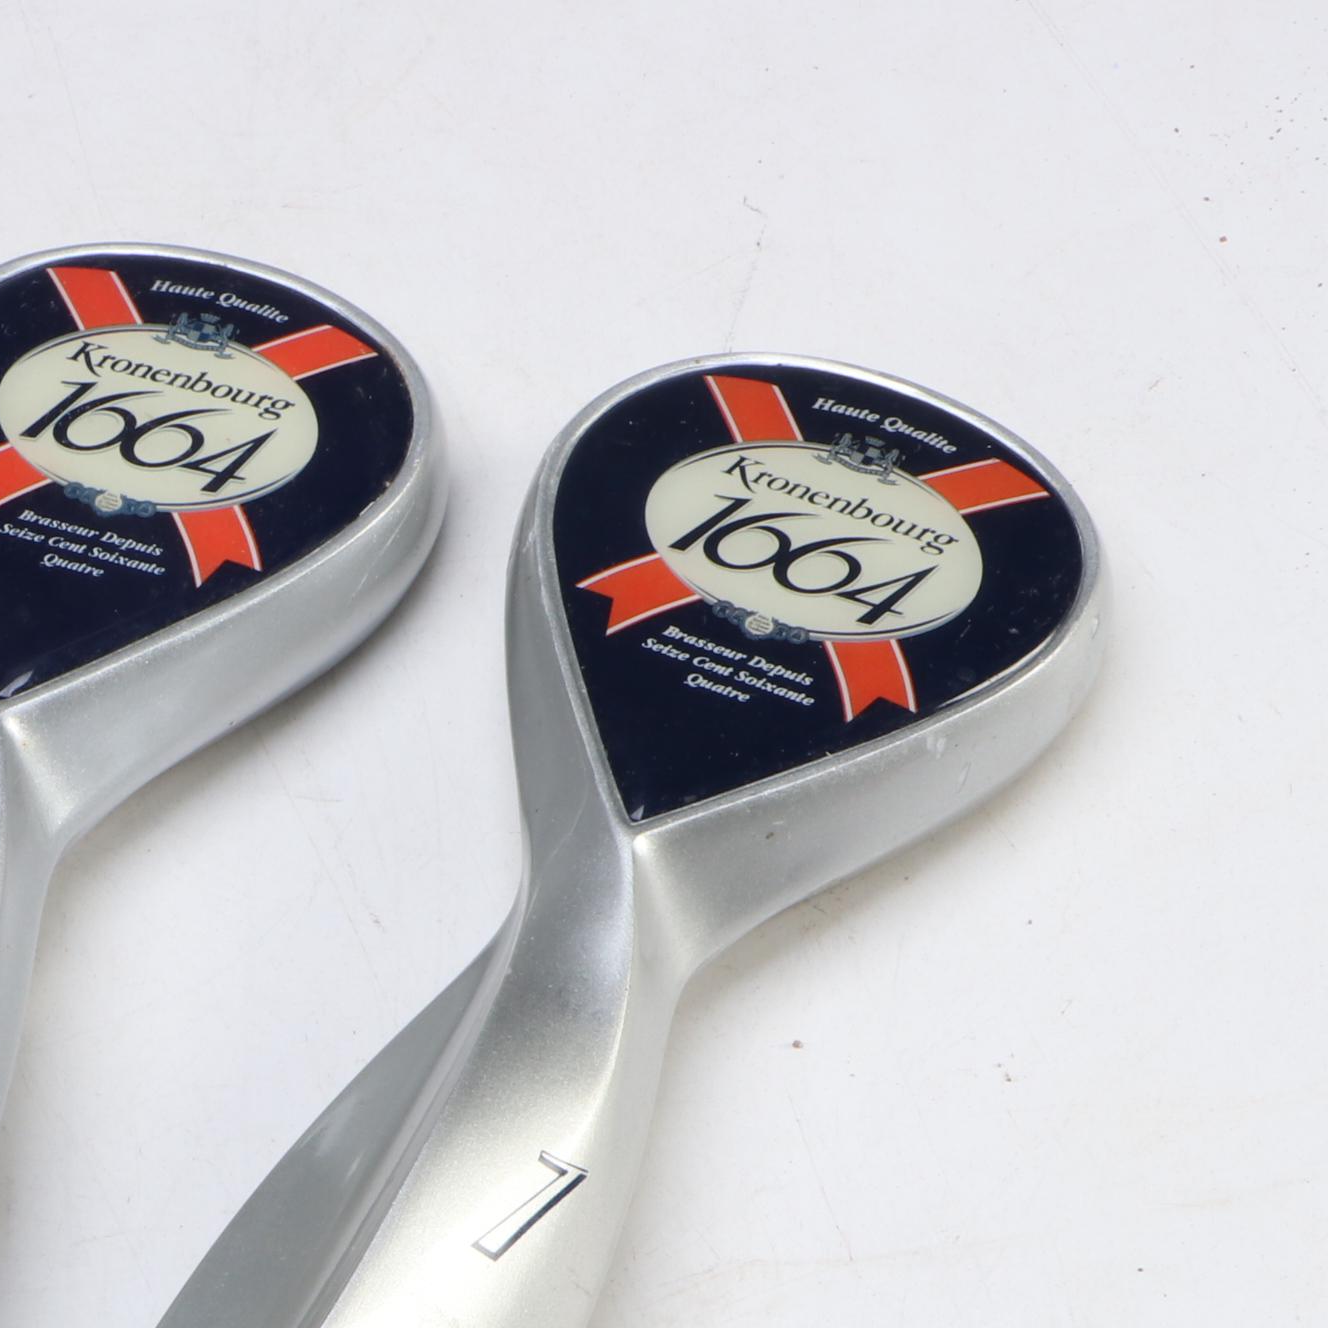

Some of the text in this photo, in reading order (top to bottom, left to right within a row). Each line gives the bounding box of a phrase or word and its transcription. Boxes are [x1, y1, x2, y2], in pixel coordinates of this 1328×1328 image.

[150, 279, 289, 323] Haute Qualite
[66, 341, 296, 420] Kronenbourg
[19, 381, 278, 494] 1664
[812, 397, 957, 454] Haute Qualite
[18, 509, 164, 557] Brasseur Depuis
[721, 455, 960, 556] Kronenbourg
[0, 523, 166, 576] Seize Cent Soixante
[40, 553, 104, 577] Quatre
[668, 493, 940, 625] 1664
[641, 638, 815, 706] Seize Cent Soixante
[662, 625, 814, 686] Brasseur Depuis
[683, 672, 751, 703] Quatre
